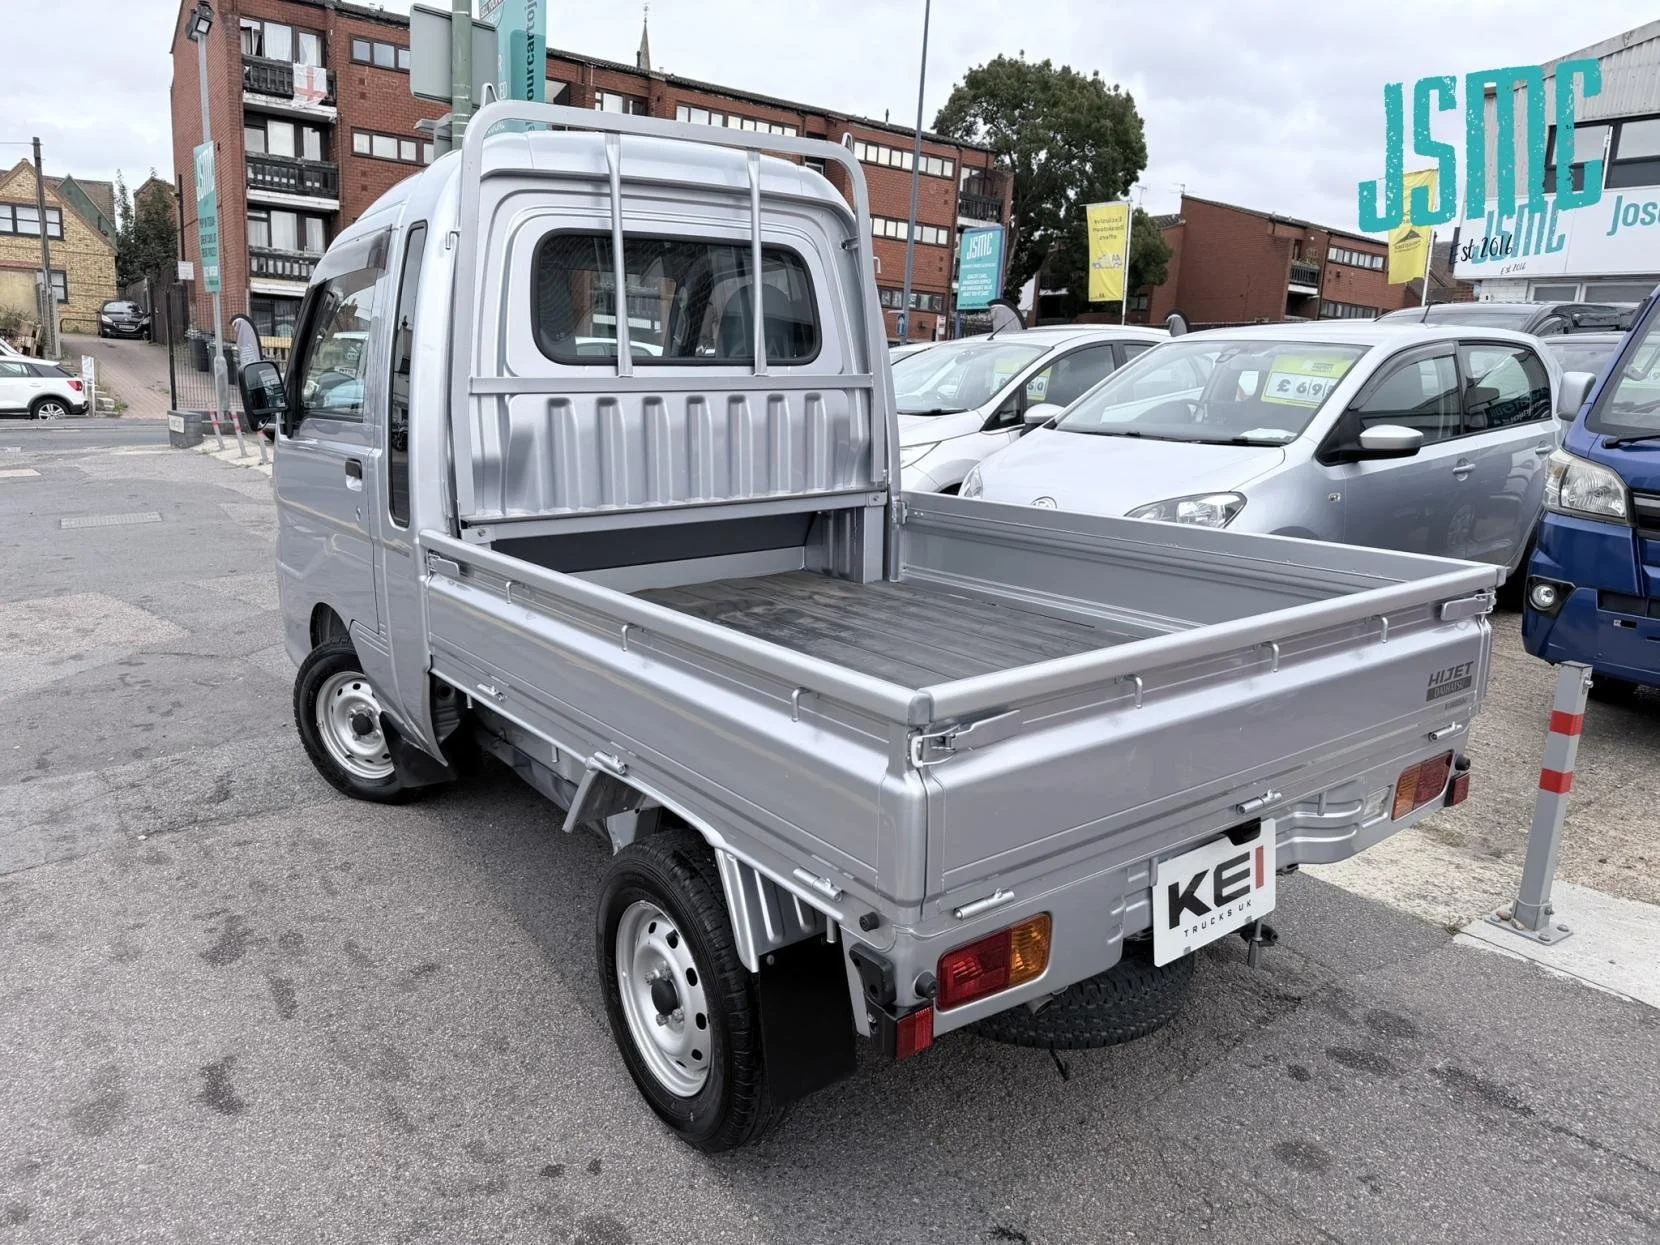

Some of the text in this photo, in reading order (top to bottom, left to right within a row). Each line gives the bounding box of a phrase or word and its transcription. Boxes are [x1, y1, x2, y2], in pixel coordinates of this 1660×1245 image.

[1606, 195, 1660, 237] Jos
[967, 233, 993, 260] JSMC
[1427, 660, 1474, 687] HIJET
[1168, 845, 1265, 930] KEI
[1184, 899, 1252, 937] TRUCKS UK
